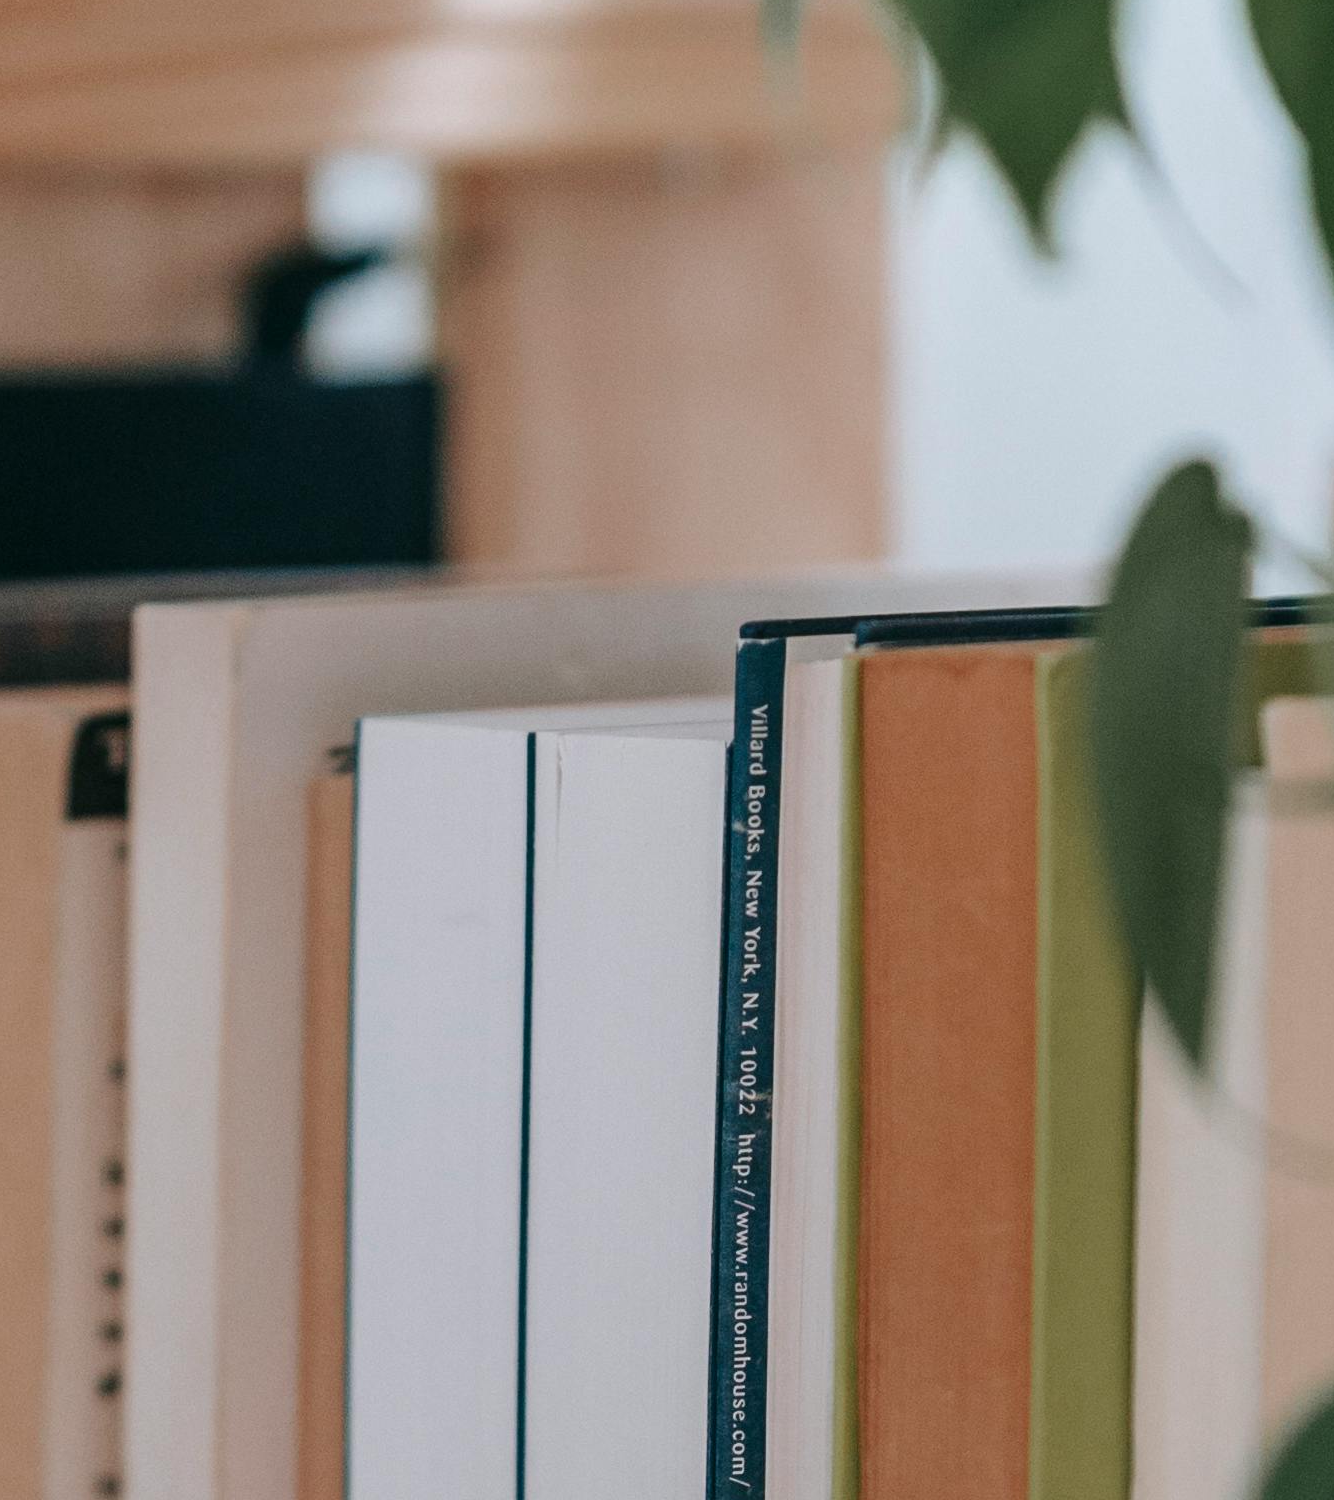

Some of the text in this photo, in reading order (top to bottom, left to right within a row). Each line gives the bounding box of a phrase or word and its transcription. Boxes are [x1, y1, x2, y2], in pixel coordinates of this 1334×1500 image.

[749, 704, 768, 775] Villard
[744, 785, 766, 861] Books,
[745, 870, 763, 918] New
[740, 926, 761, 983] York,
[741, 993, 760, 1035] N.Y.
[738, 1046, 759, 1115] 10022
[728, 1132, 756, 1488] http://www.randomhouse.com/
